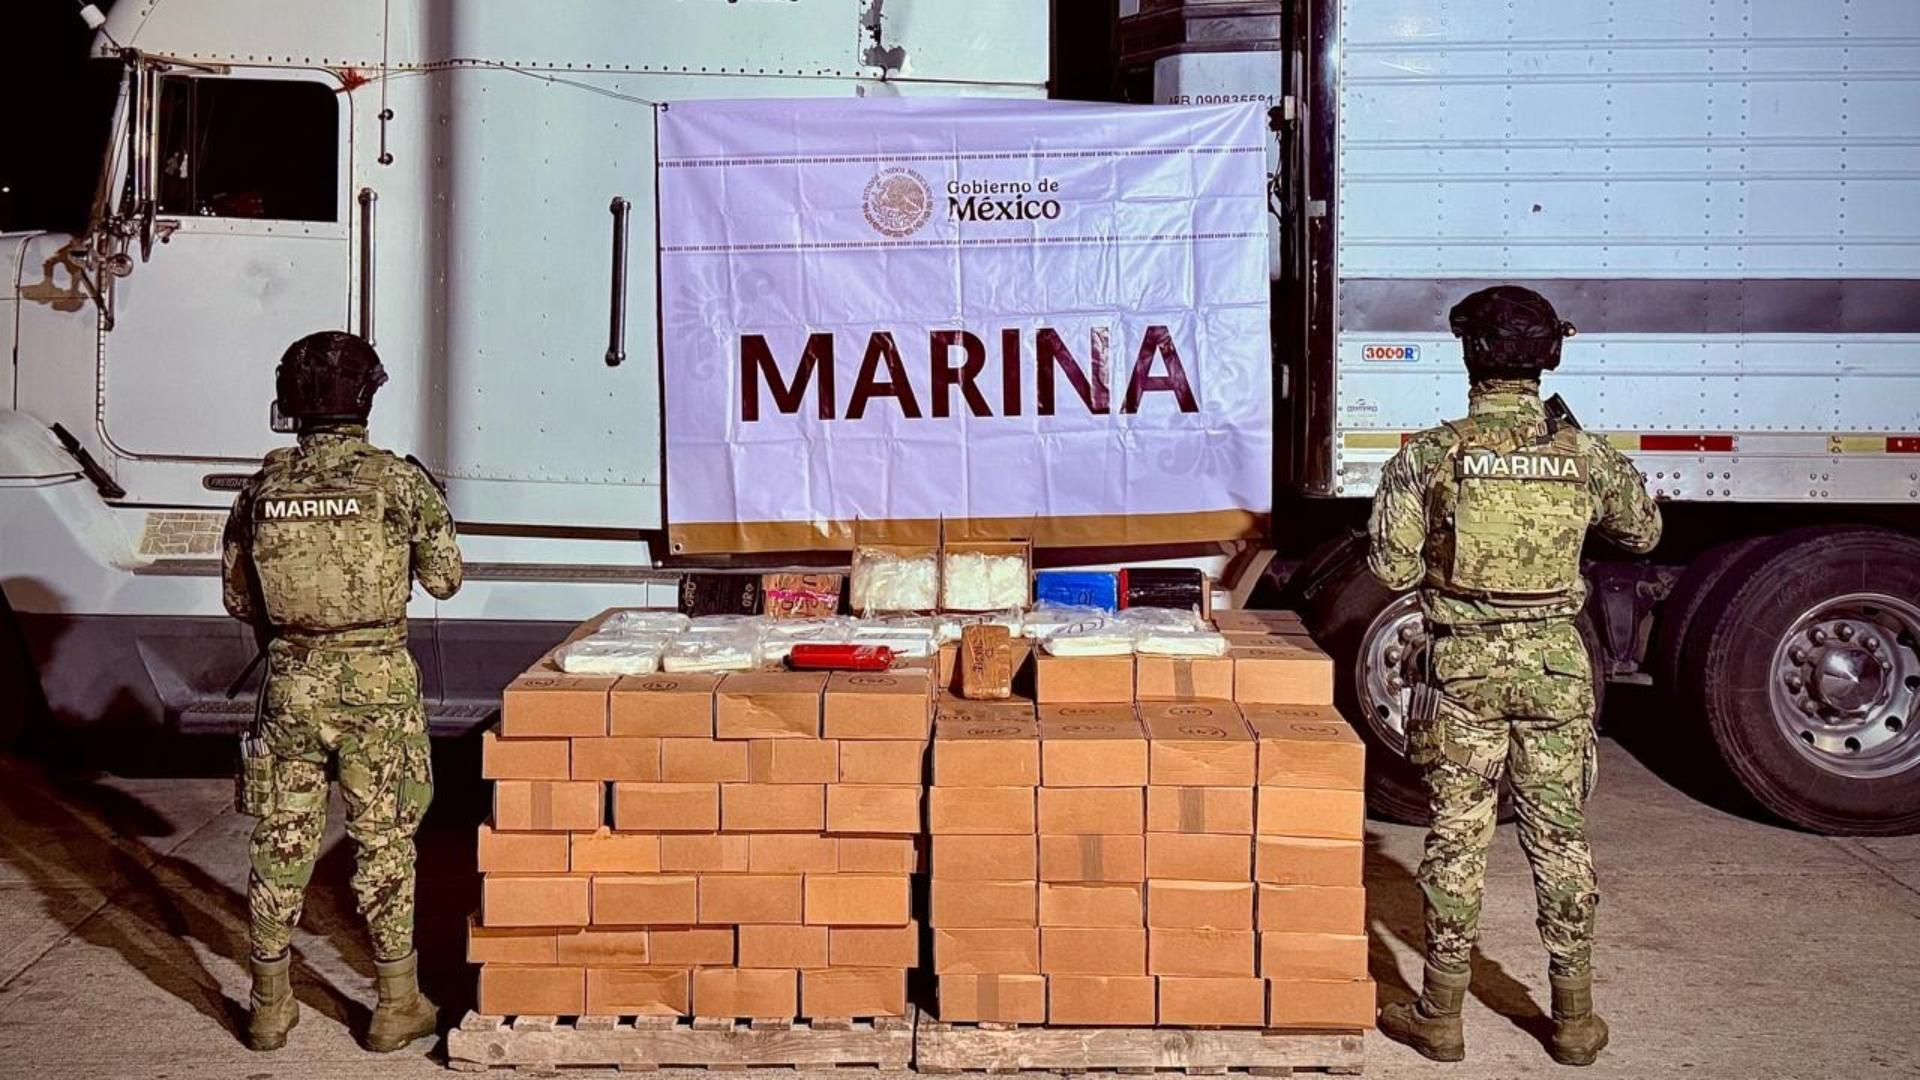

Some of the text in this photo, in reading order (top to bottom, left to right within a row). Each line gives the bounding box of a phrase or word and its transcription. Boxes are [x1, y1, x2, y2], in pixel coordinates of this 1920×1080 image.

[947, 178, 1059, 194] Gobierno de
[947, 194, 1061, 221] México
[1366, 347, 1414, 359] 3000R
[740, 324, 1200, 422] MARINA
[1463, 455, 1580, 478] MARINA
[264, 498, 361, 518] MARINA
